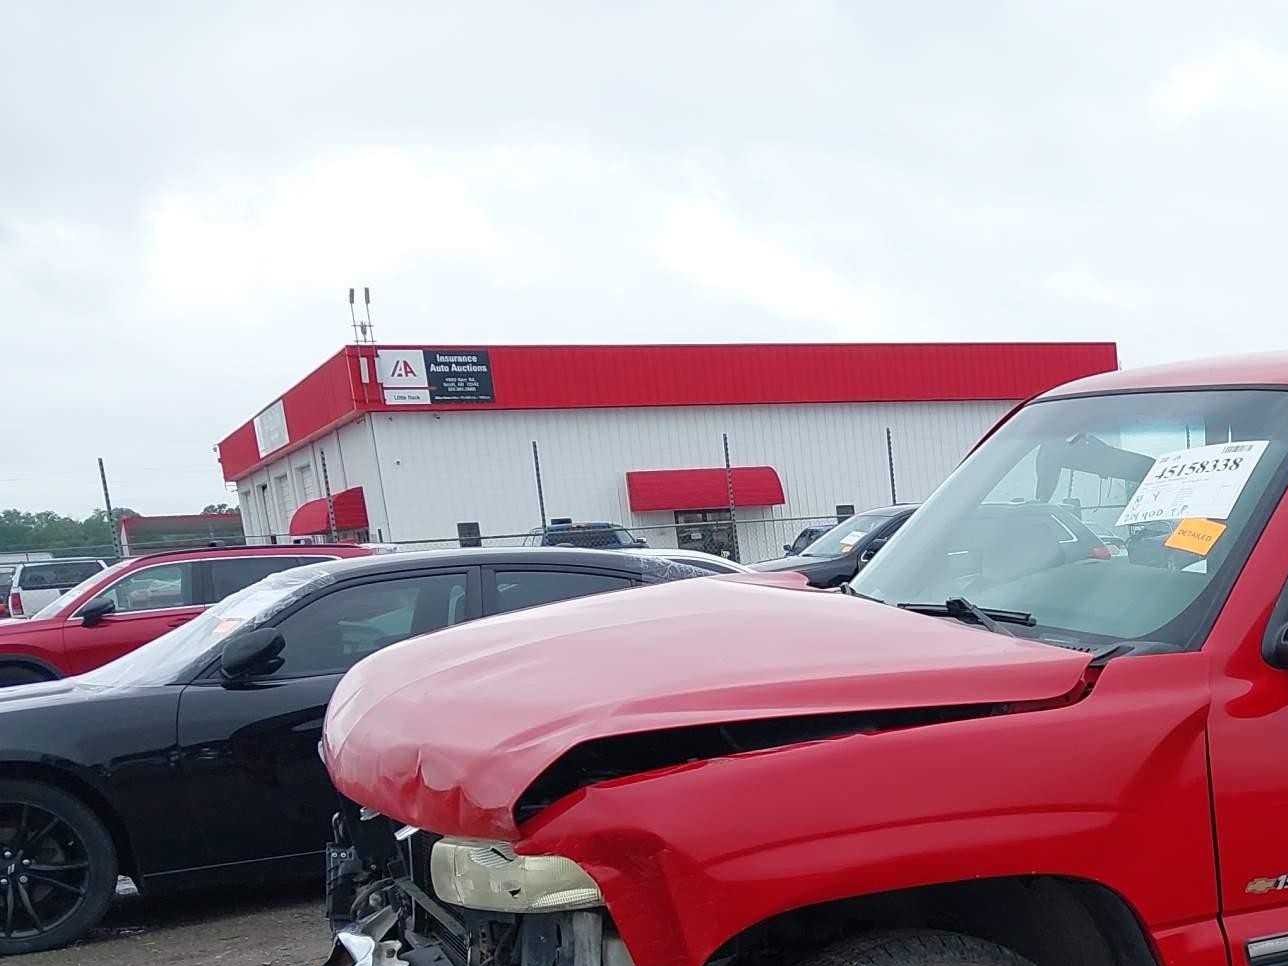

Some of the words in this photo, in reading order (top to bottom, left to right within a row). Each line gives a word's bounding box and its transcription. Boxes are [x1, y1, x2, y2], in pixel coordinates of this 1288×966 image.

[436, 354, 478, 362] Insurance
[430, 363, 450, 372] Auto
[451, 363, 488, 372] Auctions
[1155, 457, 1243, 480] 45158338
